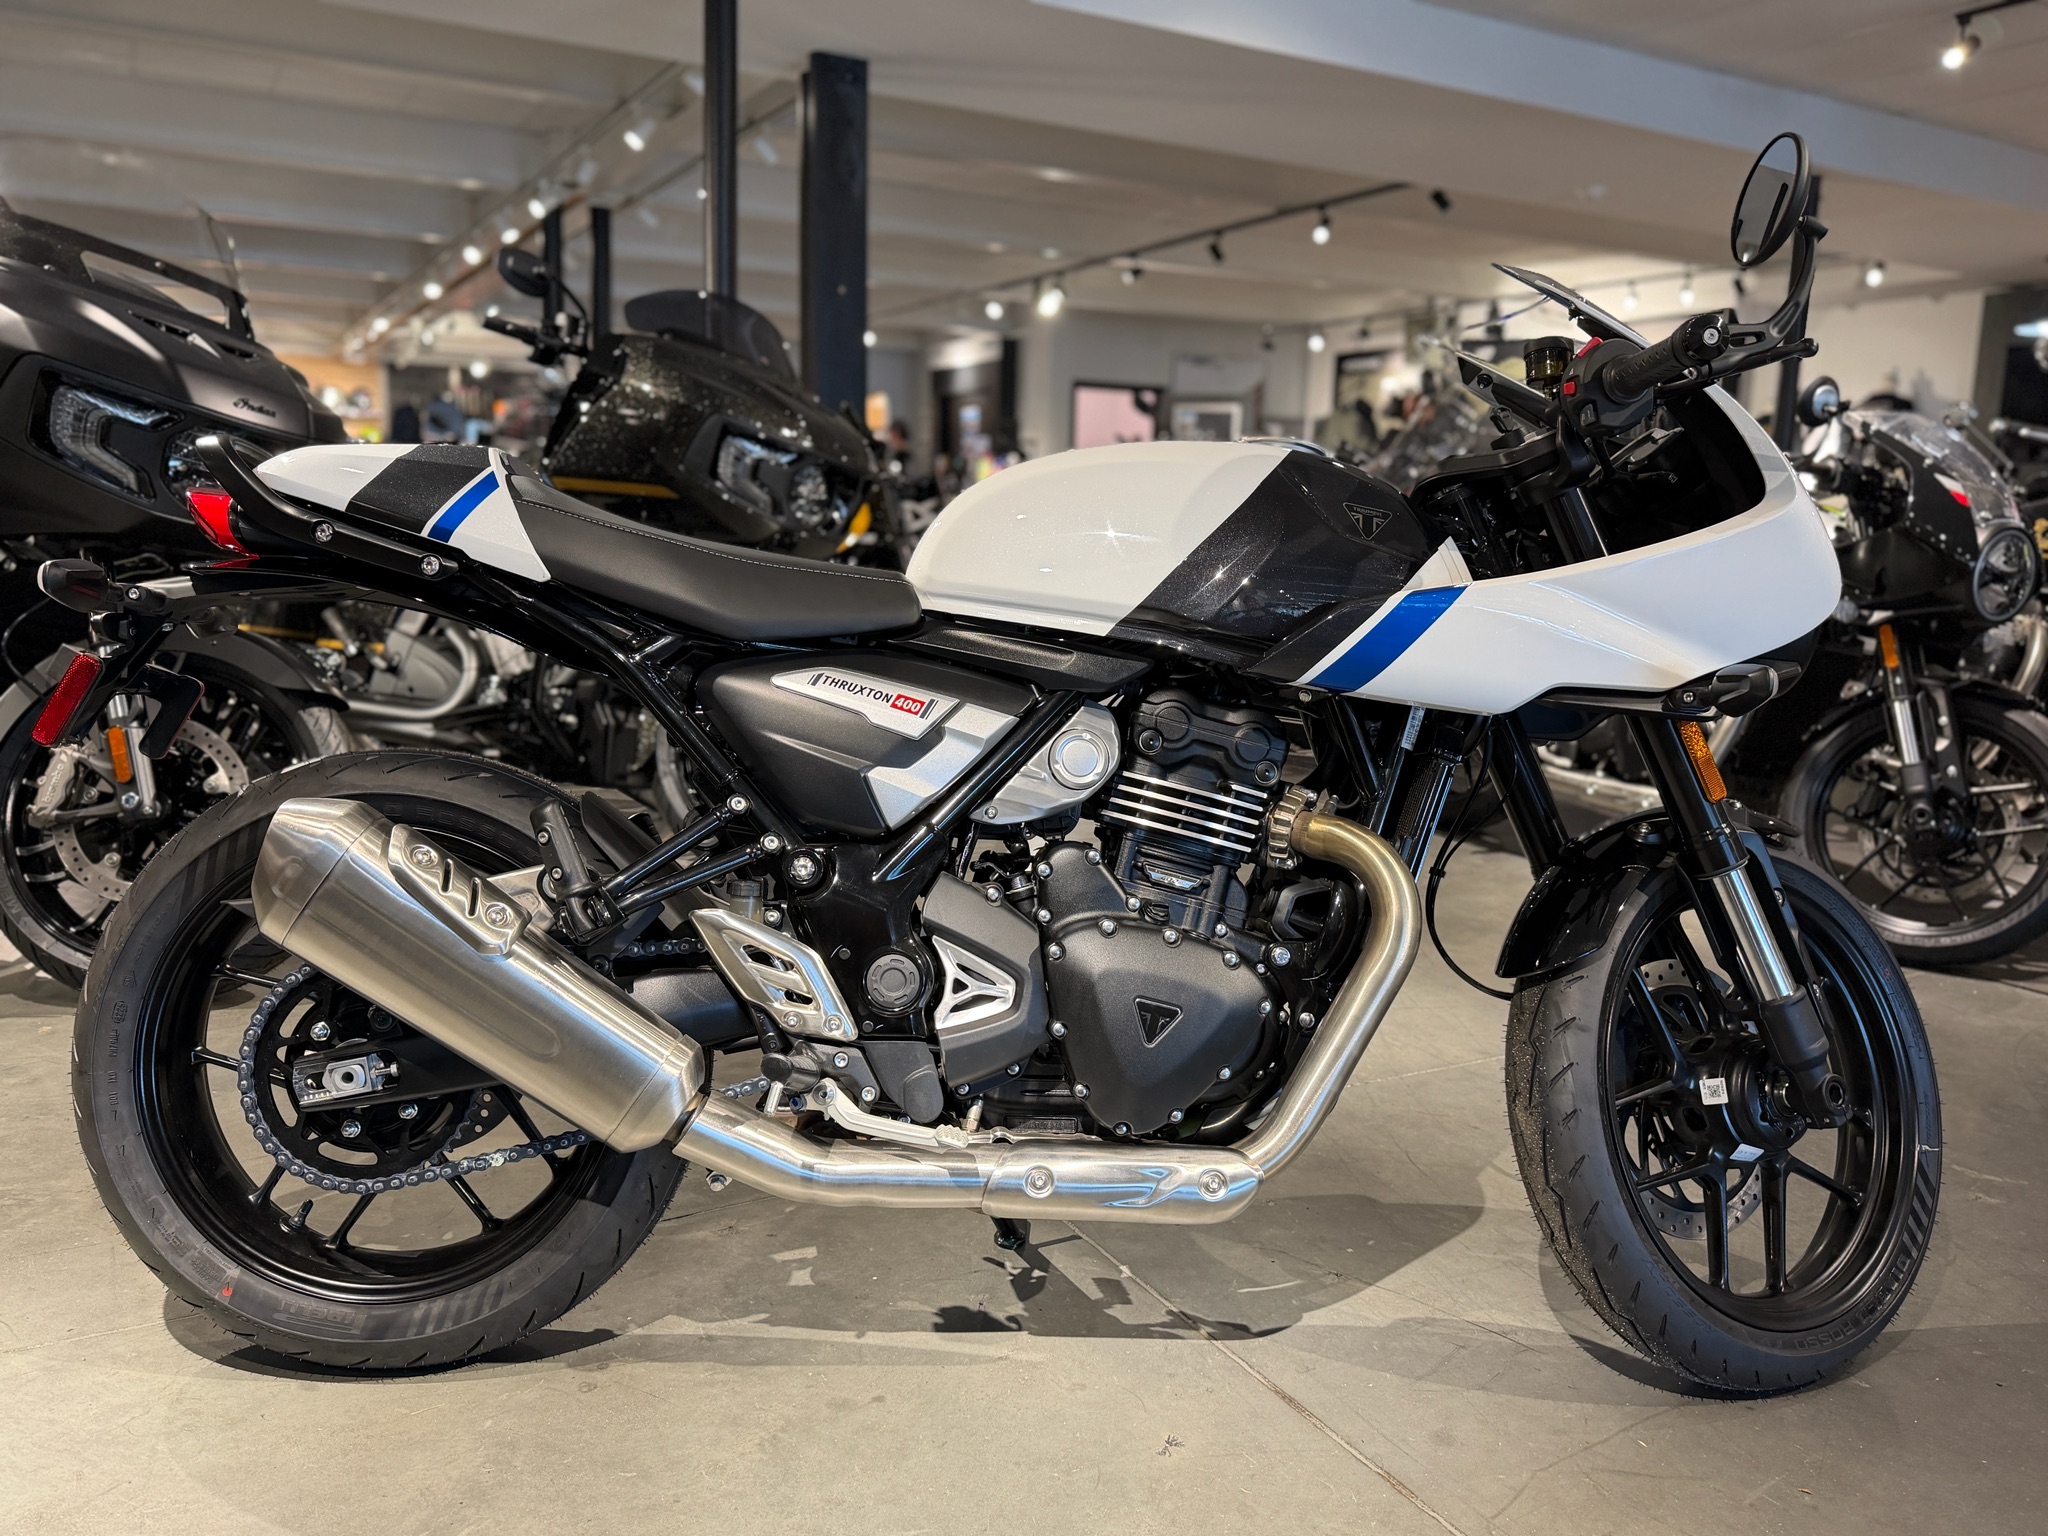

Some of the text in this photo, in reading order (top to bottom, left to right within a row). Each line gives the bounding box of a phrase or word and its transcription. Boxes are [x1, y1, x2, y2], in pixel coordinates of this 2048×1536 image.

[1353, 507, 1382, 517] TRIUMPH
[822, 675, 921, 712] THRUXTON 400
[41, 763, 64, 804] brembo
[1794, 1321, 1856, 1350] ROSSO
